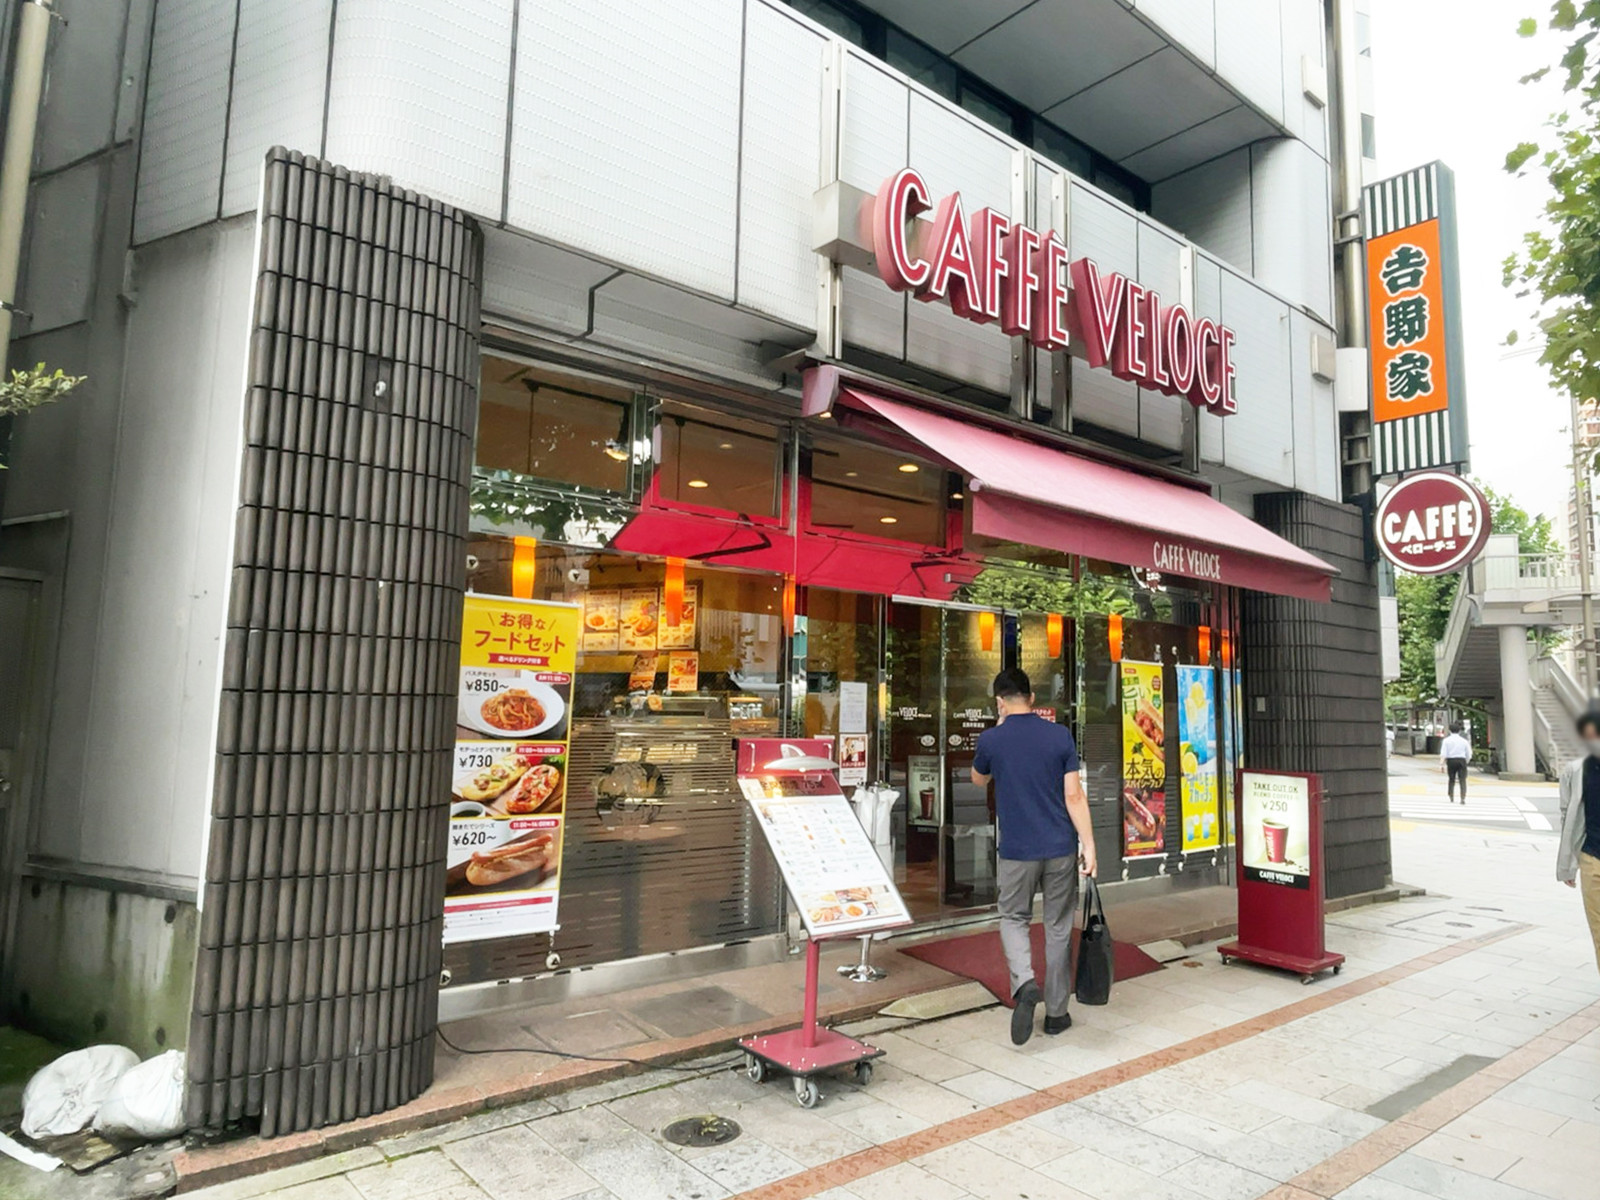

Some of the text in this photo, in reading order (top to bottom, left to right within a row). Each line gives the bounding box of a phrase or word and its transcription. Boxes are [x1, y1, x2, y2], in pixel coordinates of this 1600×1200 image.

[1380, 244, 1432, 401] 吉野家
[1080, 258, 1237, 414] VELOCE
[1400, 540, 1456, 555] ベローチェ
[1186, 548, 1221, 580] VELOCE
[499, 612, 546, 630] お得な
[474, 629, 566, 653] フードセット
[459, 755, 493, 768] ¥730
[1125, 758, 1164, 780] 本気の
[1253, 782, 1298, 793] TAKE OUT OK
[1262, 801, 1288, 812] ¥250
[1275, 873, 1295, 883] VELOCE
